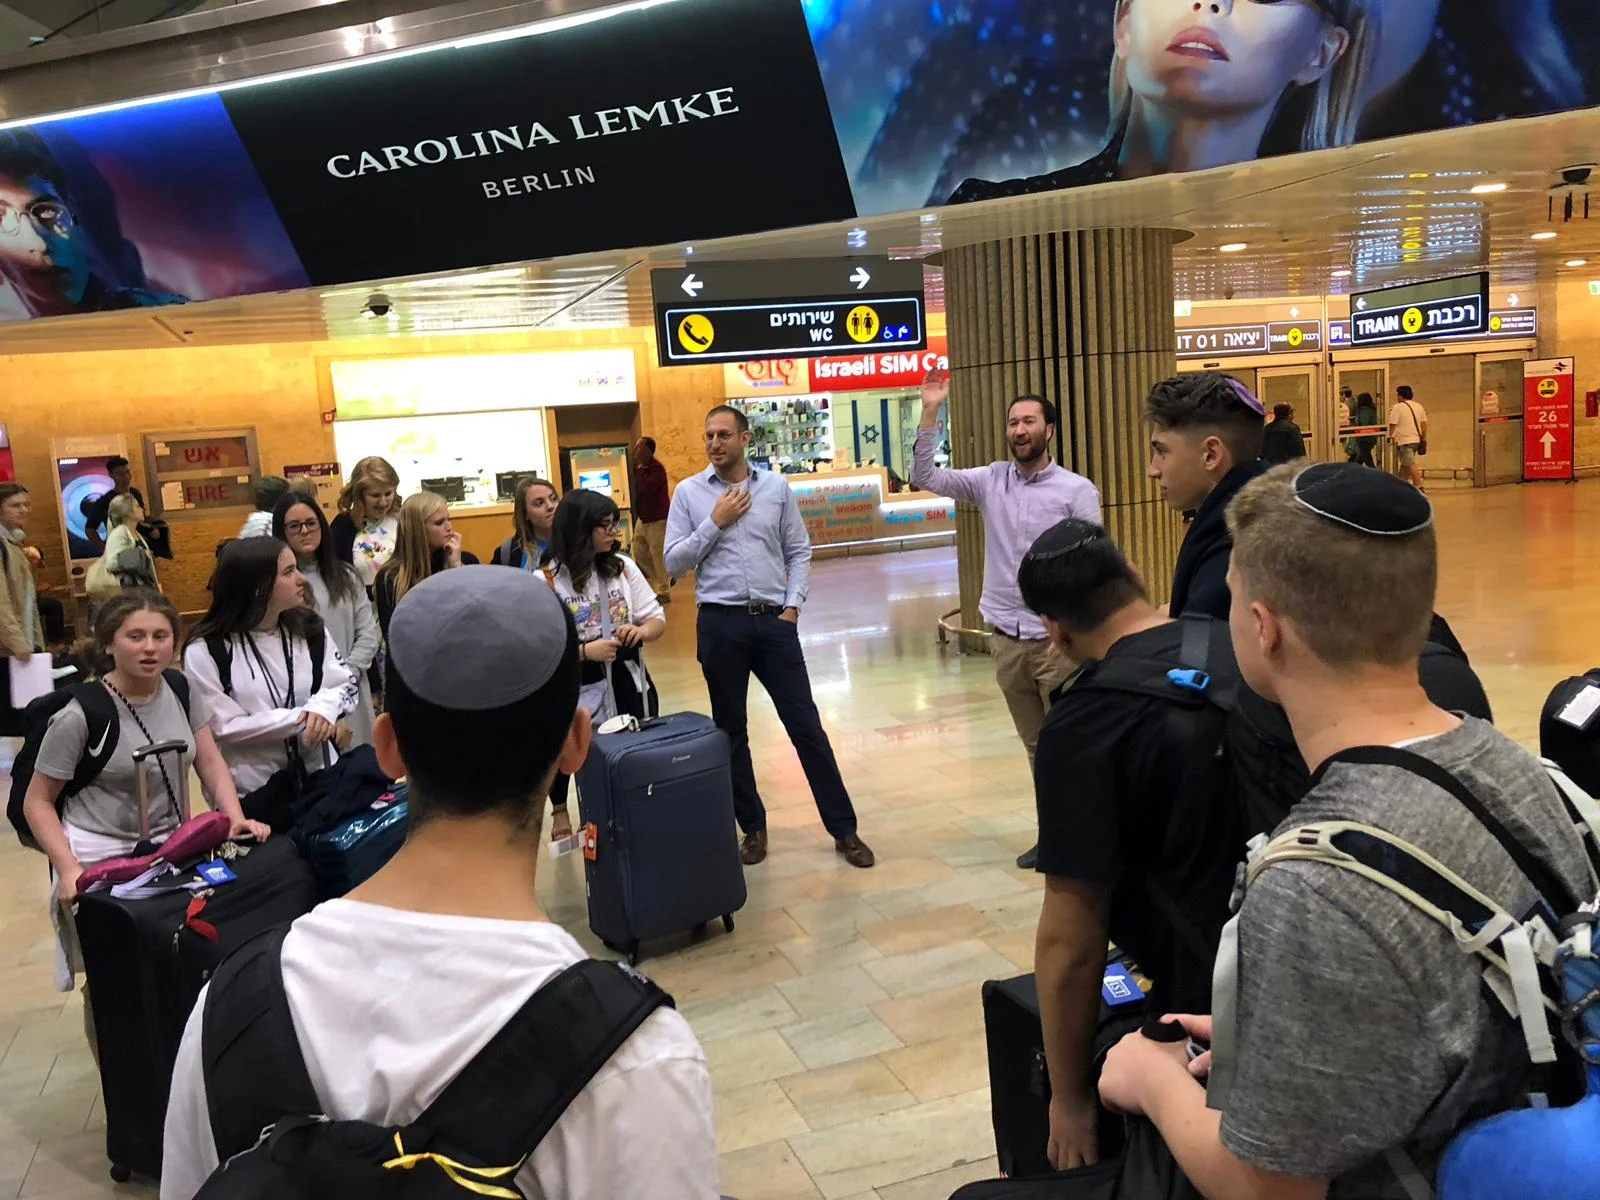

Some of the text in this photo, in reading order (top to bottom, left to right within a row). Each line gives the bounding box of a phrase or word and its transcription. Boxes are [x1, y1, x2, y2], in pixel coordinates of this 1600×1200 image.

[327, 87, 740, 179] CAROLINA LEMKE
[482, 165, 597, 200] BERLIN
[770, 310, 835, 328] שירותים
[1356, 314, 1399, 335] TRAIN
[1427, 304, 1475, 327] רכבת
[809, 328, 833, 342] WC
[1177, 335, 1193, 350] IT
[1223, 331, 1260, 347] יציאה
[815, 354, 876, 378] Israeli
[880, 353, 919, 374] SIM
[921, 352, 949, 371] Ca
[1538, 411, 1557, 422] 26
[184, 446, 221, 463] אש
[186, 483, 229, 503] FIRE
[926, 509, 946, 520] SIM
